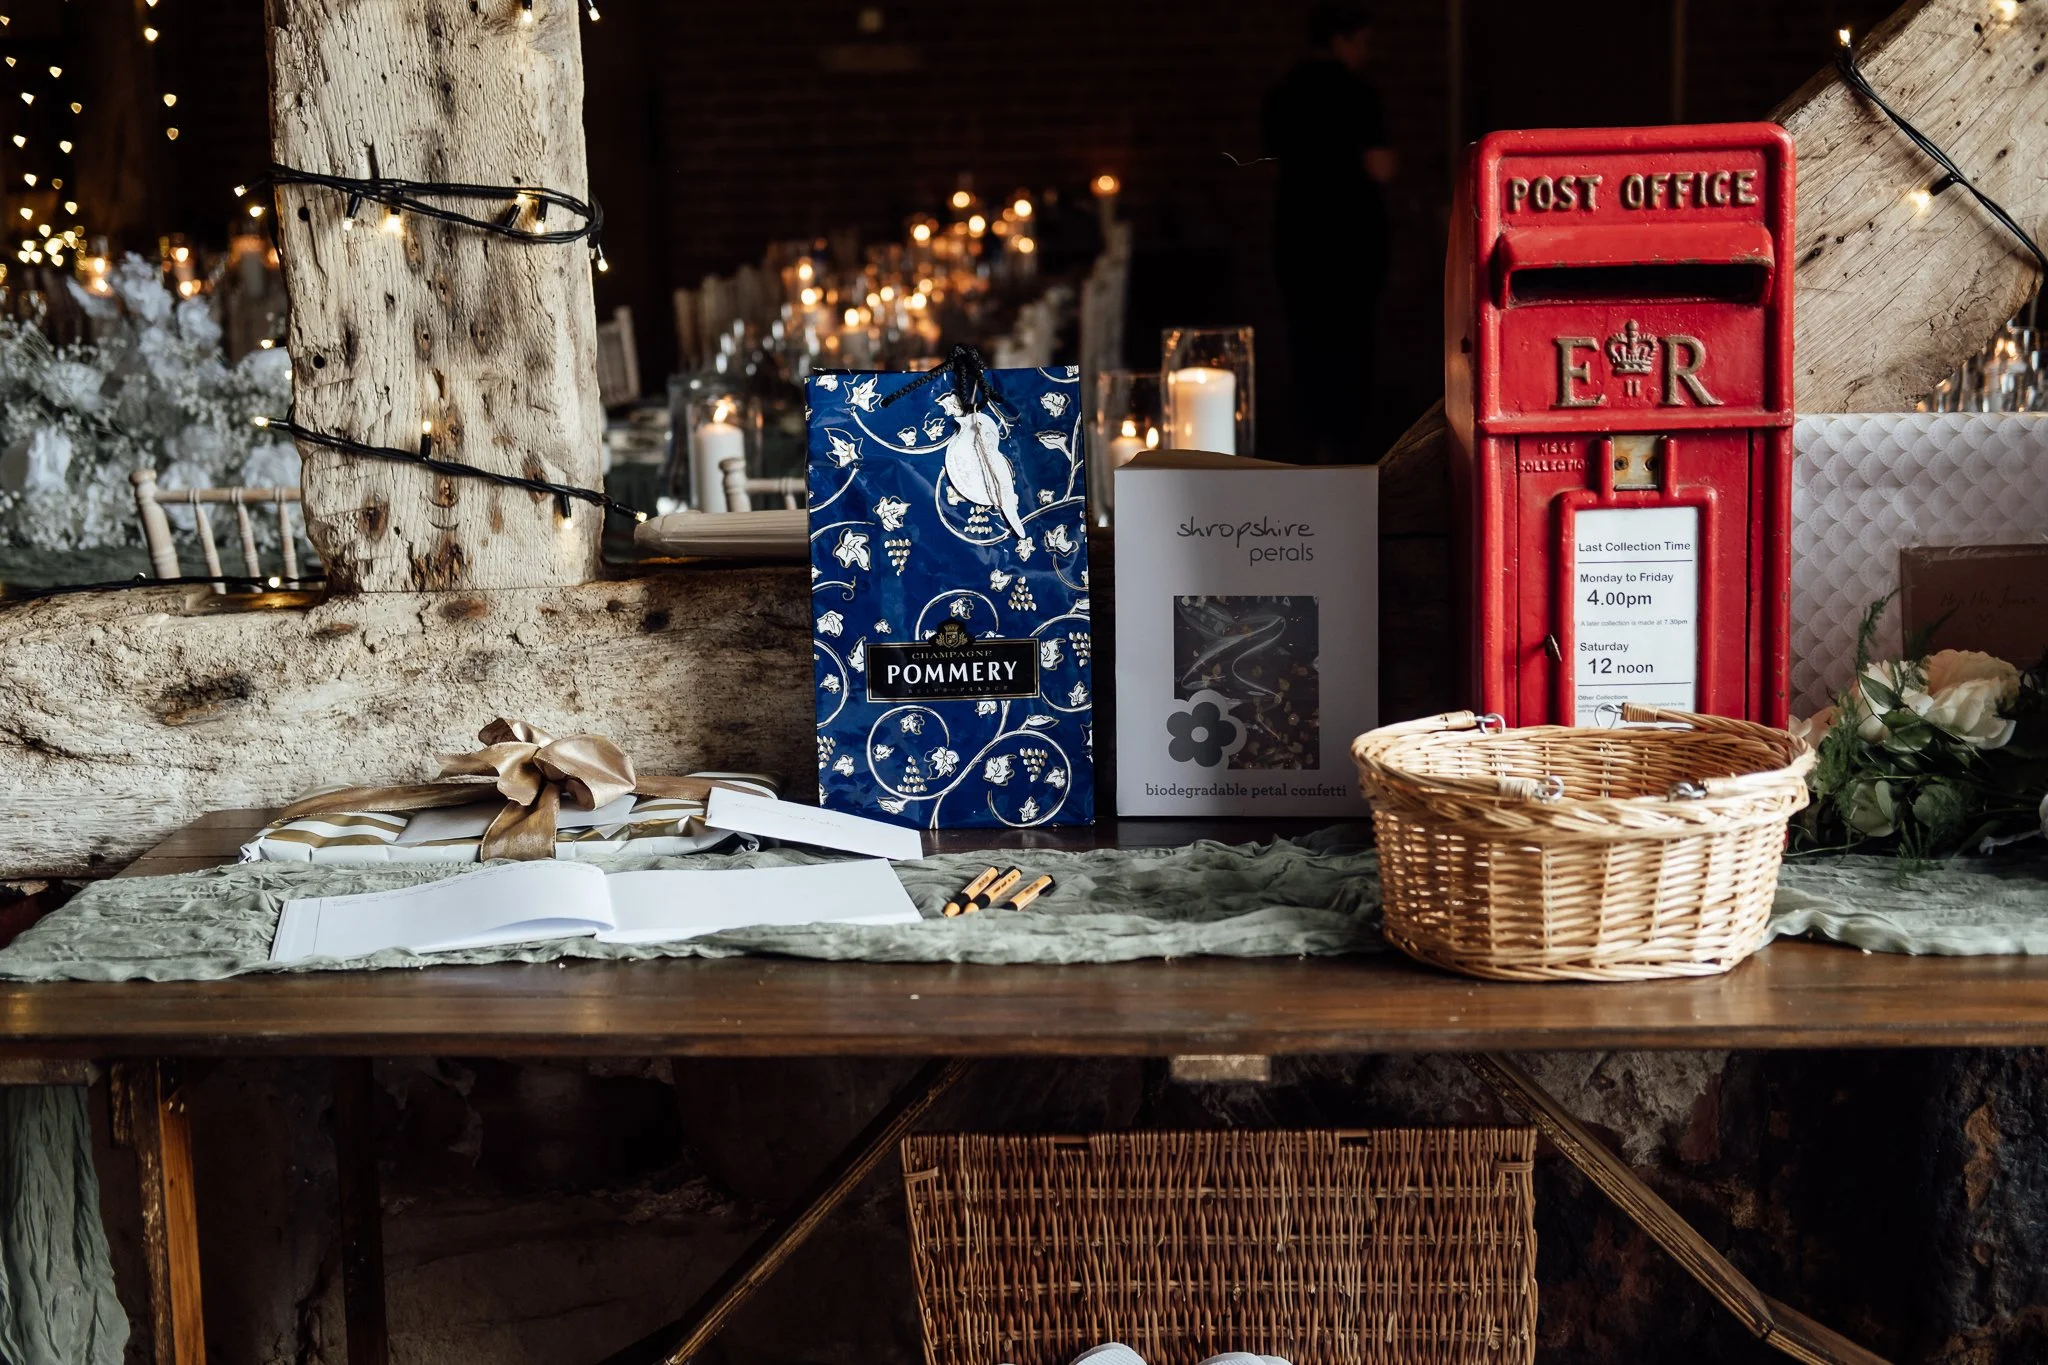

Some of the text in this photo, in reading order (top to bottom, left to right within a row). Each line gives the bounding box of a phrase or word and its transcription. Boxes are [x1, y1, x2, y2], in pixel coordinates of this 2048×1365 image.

[1510, 169, 1758, 212] POST OFFICE
[1550, 335, 1724, 408] E R
[1537, 441, 1576, 455] NEXT
[1519, 458, 1587, 472] COLLECTIO
[1177, 516, 1314, 548] shropshire
[1250, 543, 1314, 566] petals
[1578, 541, 1691, 552] Last Collection Time
[1580, 573, 1674, 584] Monday to Friday
[1587, 589, 1652, 608] 4.00pm
[911, 650, 993, 660] CHAMPAGNE
[1580, 642, 1629, 652] Saturday
[887, 661, 1018, 684] POMMERY
[1588, 657, 1654, 674] 12 noon
[1145, 783, 1347, 798] biodegradable petal confetti
